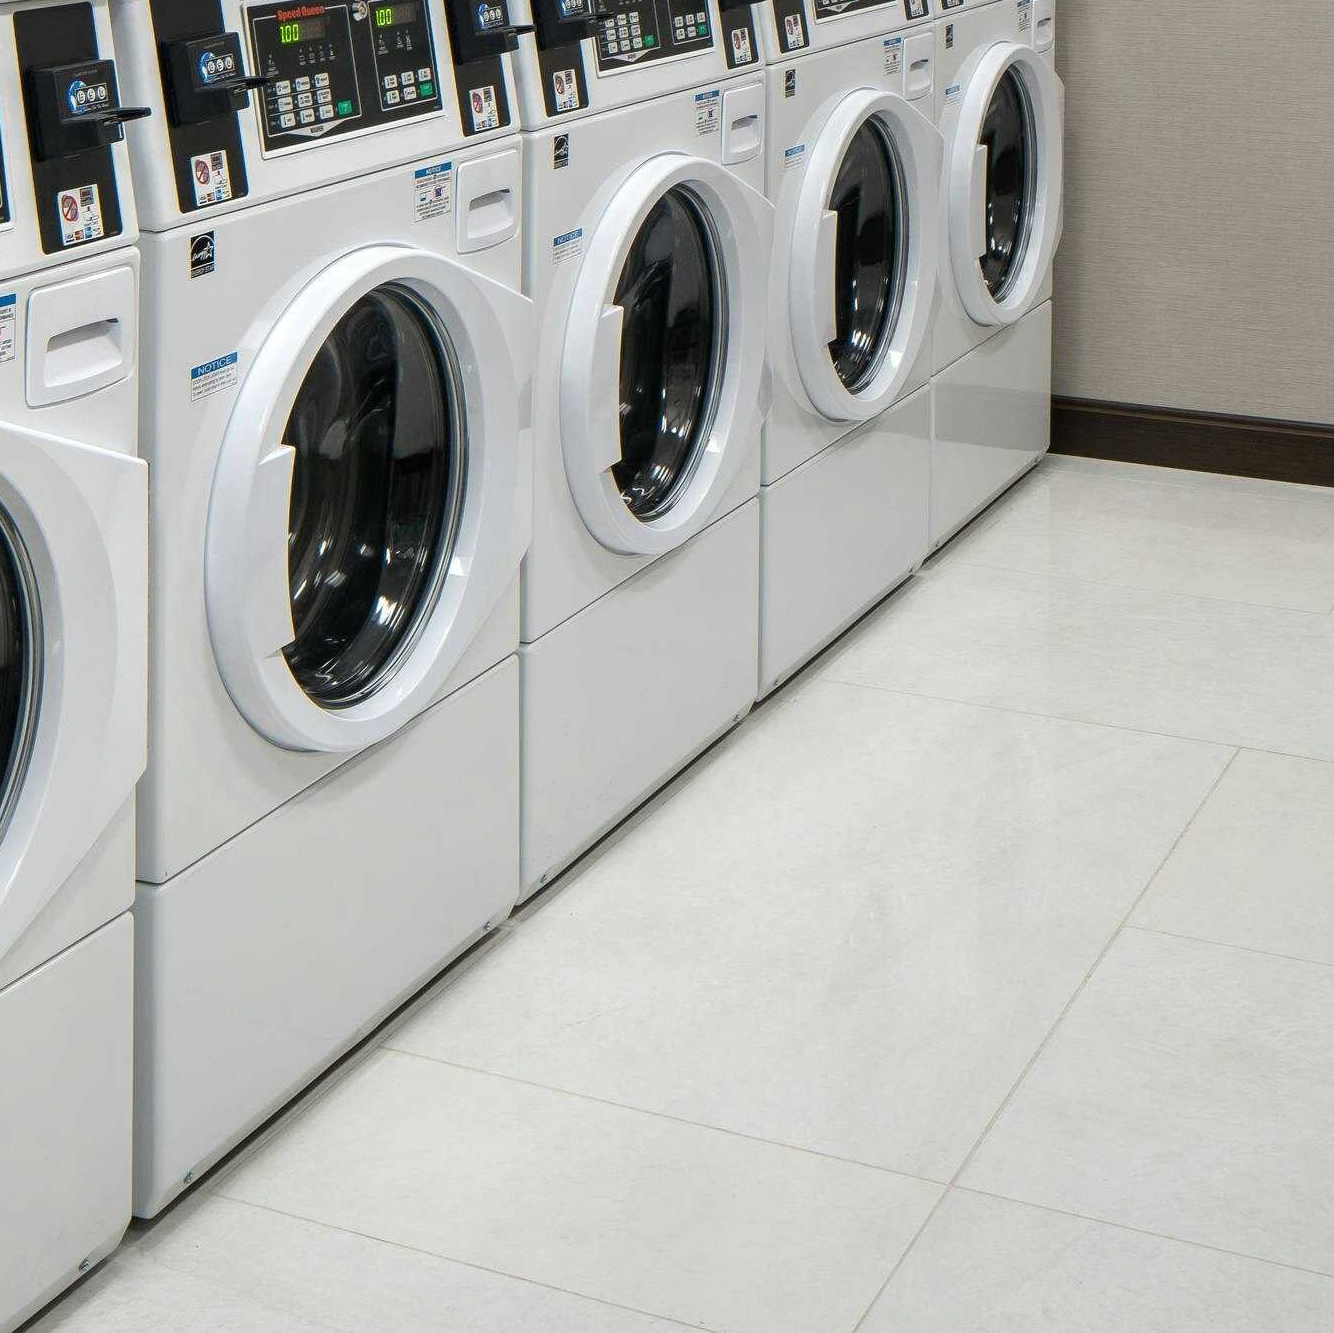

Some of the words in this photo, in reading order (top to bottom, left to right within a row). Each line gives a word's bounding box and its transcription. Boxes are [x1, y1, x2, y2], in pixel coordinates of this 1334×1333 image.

[277, 8, 301, 22] Speed
[302, 6, 325, 15] Queen
[557, 231, 579, 244] NOTICE
[198, 356, 232, 375] NOTICE
